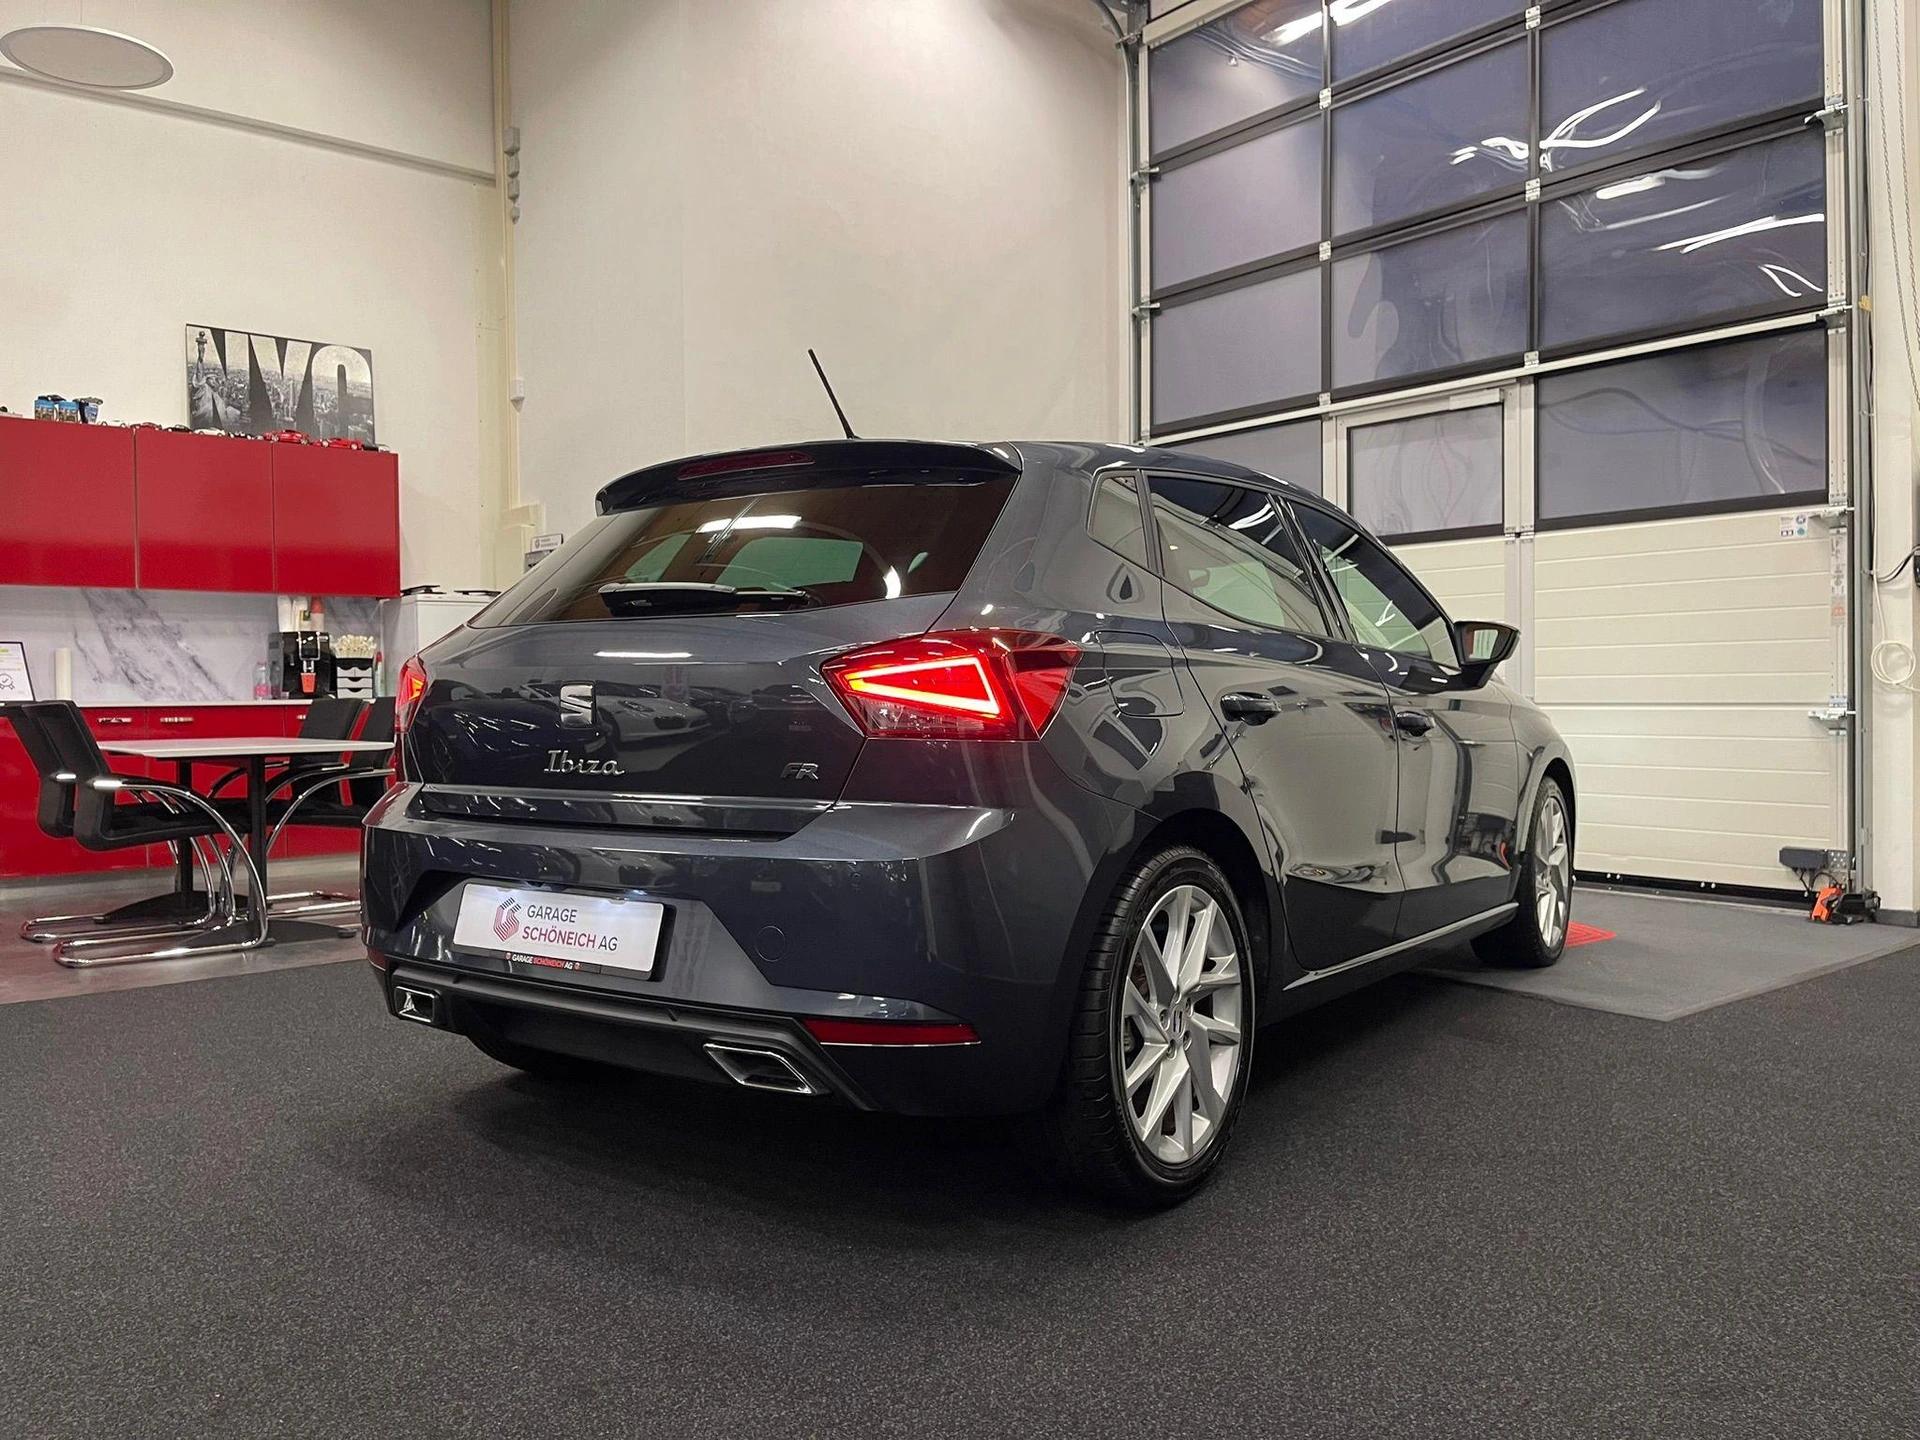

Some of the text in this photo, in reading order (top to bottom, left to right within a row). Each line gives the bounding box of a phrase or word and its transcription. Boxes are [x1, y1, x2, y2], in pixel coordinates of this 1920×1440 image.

[543, 750, 626, 776] Ibiza
[780, 762, 819, 780] FR
[527, 904, 577, 923] GARAGE
[522, 925, 618, 951] SCHÖNEICH AG
[511, 954, 533, 964] GARAGE
[564, 962, 573, 970] AG
